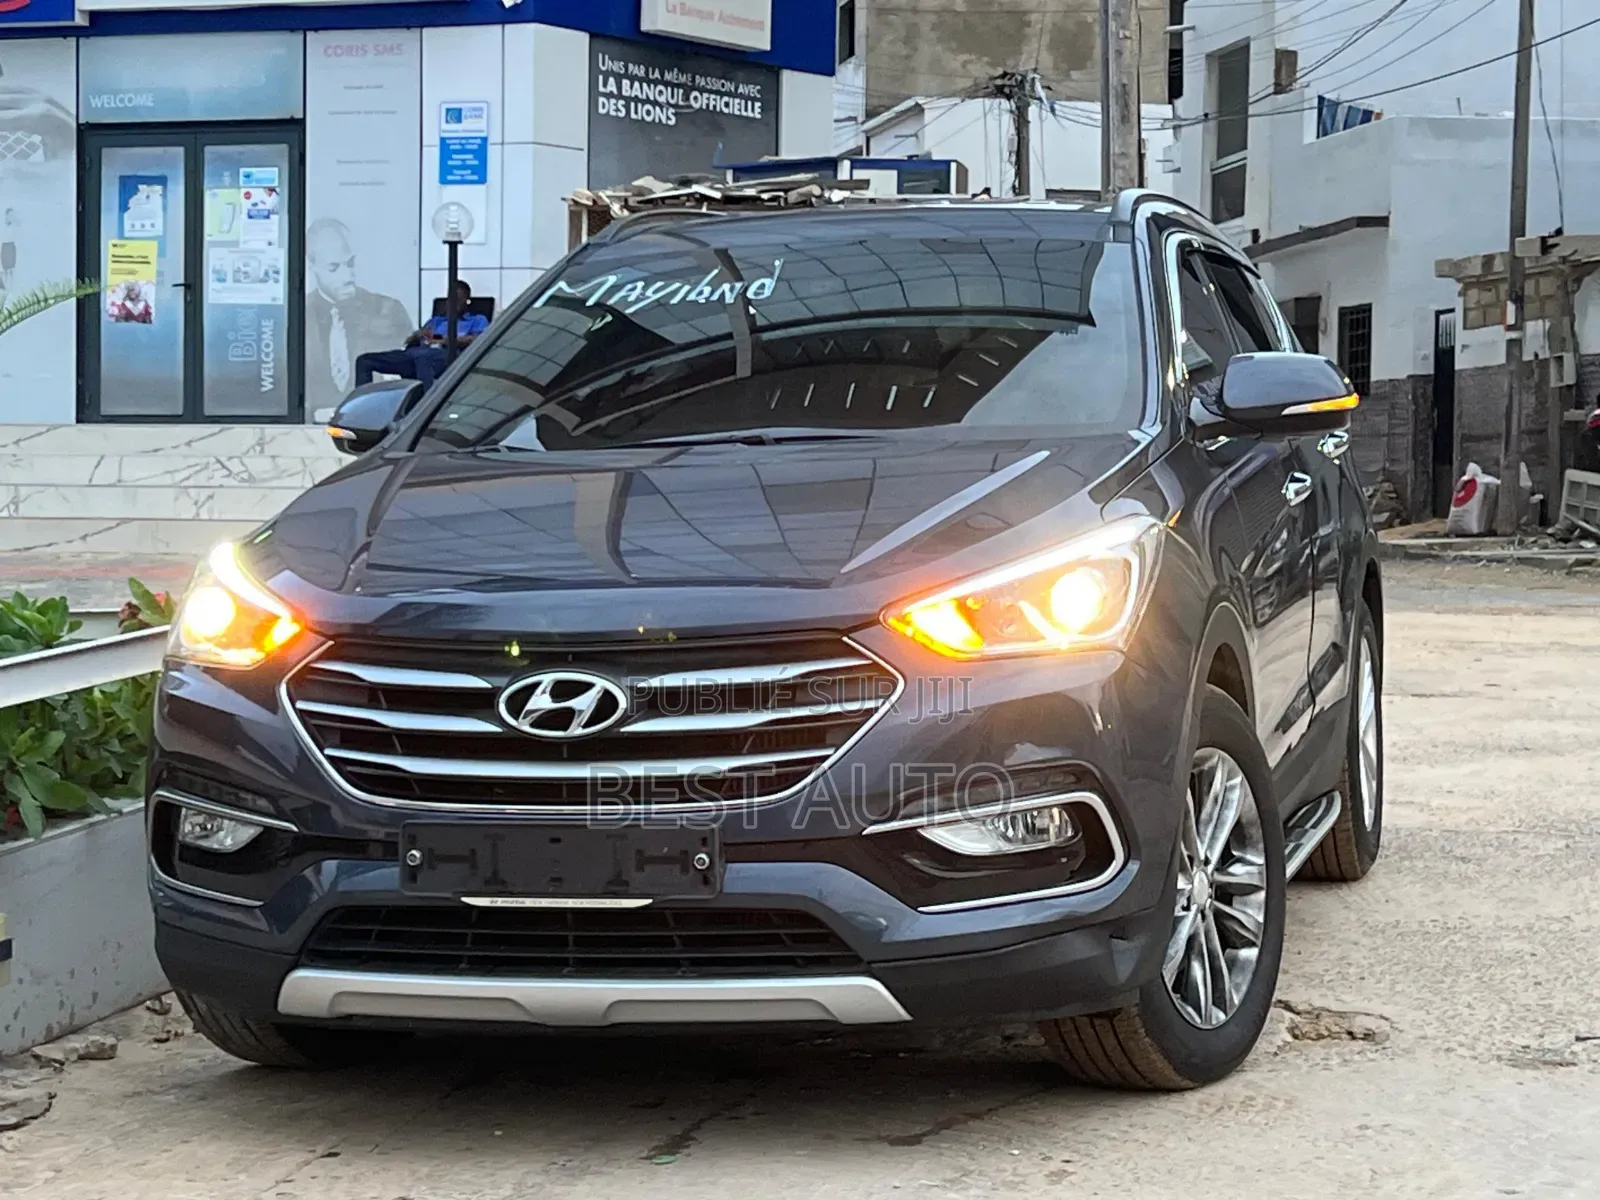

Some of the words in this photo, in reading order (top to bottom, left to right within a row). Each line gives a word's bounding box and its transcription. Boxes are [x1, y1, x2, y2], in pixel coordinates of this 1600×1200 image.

[323, 43, 368, 58] CORIS
[628, 63, 646, 78] PAR
[649, 67, 661, 80] LA
[664, 68, 692, 86] MÊME
[695, 75, 735, 93] PASSION
[737, 83, 761, 98] AVEC
[88, 92, 155, 108] WELCOME
[598, 75, 618, 95] LA
[689, 90, 762, 119] OFFICIELLE
[598, 97, 626, 118] DES
[630, 101, 676, 126] LIONS
[260, 318, 275, 393] WELCOME
